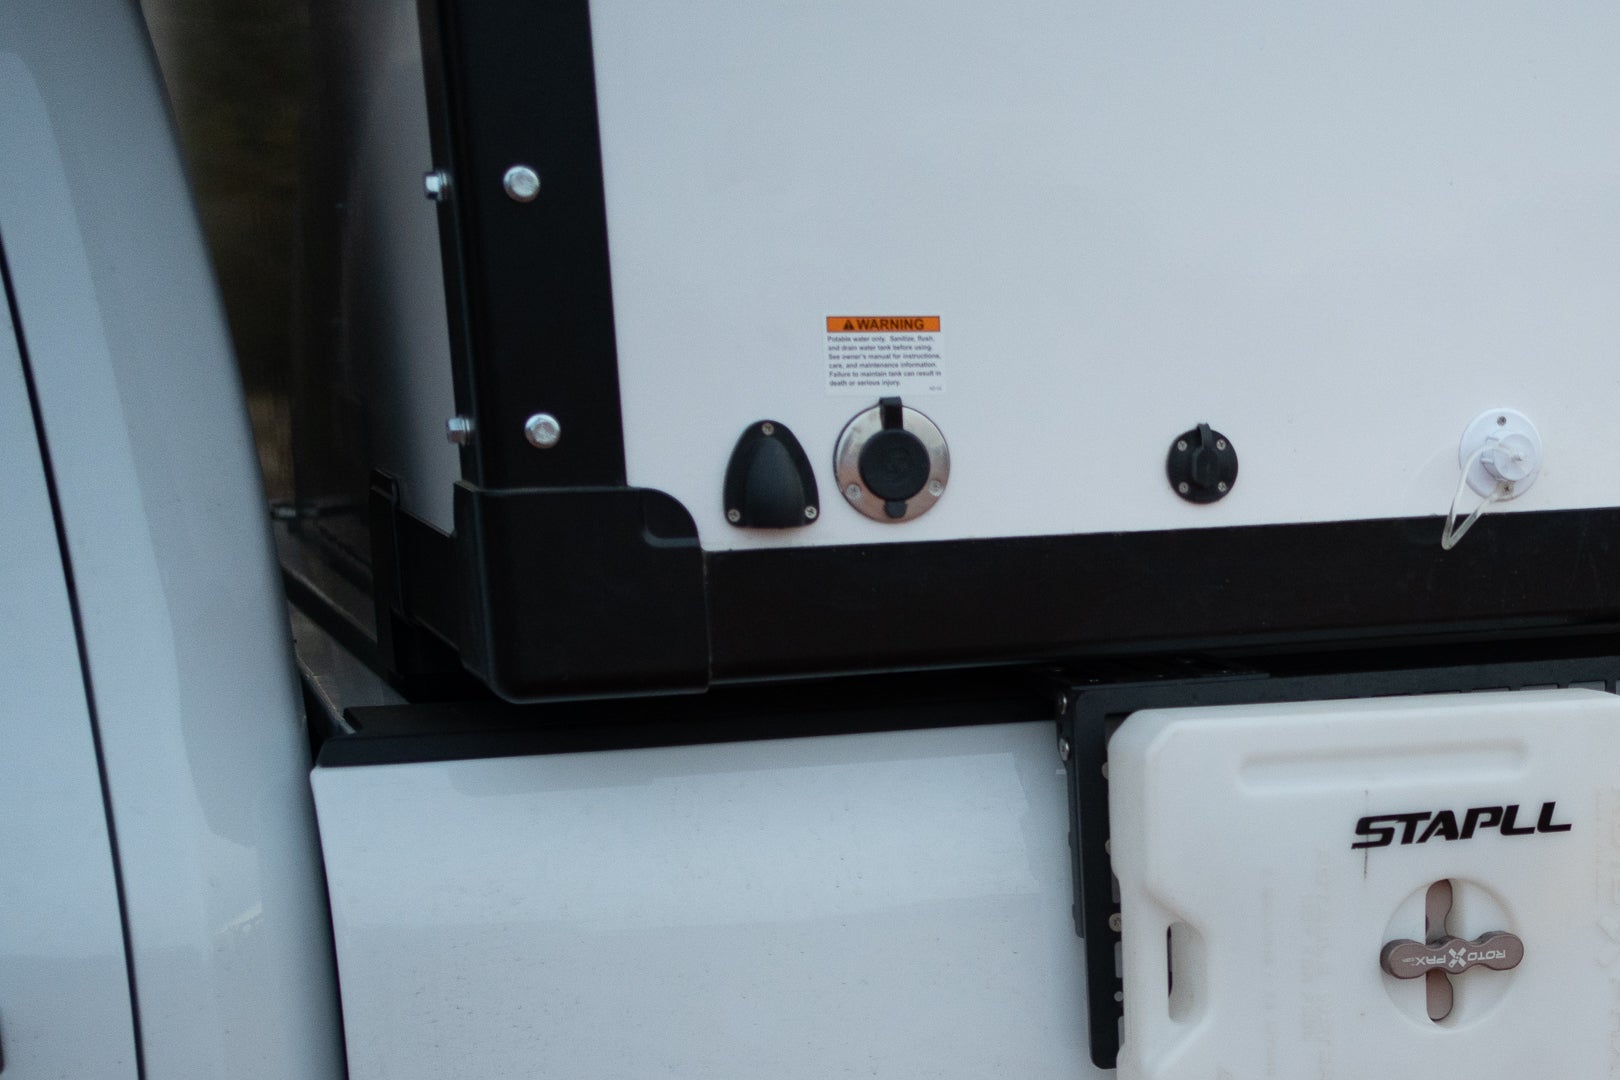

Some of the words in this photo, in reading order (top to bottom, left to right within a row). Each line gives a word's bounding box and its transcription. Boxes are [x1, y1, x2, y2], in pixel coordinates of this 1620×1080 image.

[857, 318, 924, 330] WARNING
[1351, 801, 1572, 849] STAPLL
[1467, 949, 1506, 961] ROTO
